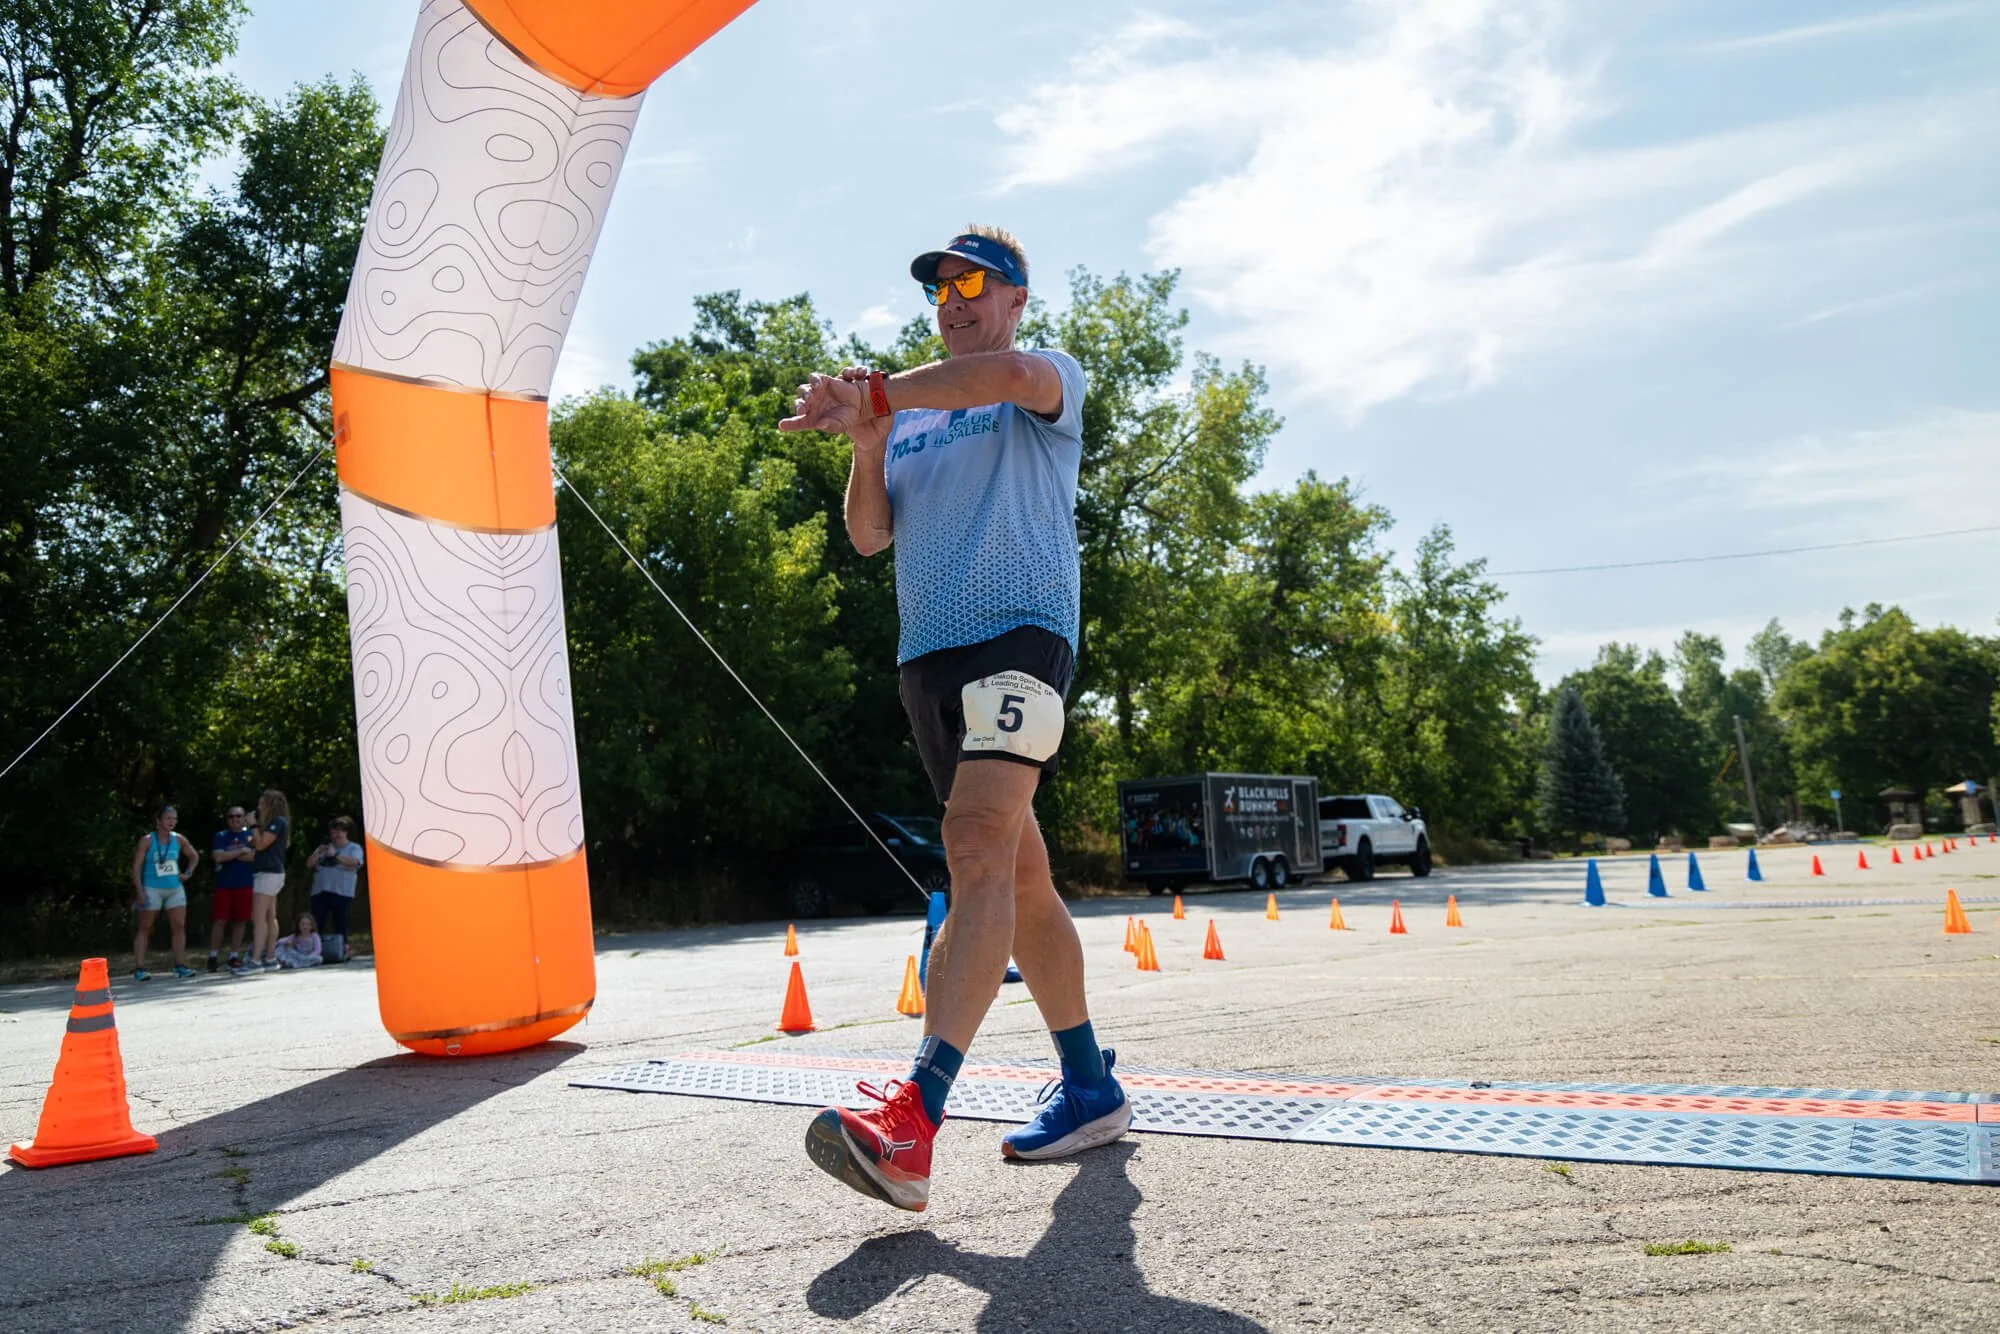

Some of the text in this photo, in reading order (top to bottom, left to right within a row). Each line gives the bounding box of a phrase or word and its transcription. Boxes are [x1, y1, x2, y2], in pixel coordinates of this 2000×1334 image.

[891, 432, 928, 463] 70.3
[991, 679, 1019, 689] Leading
[996, 693, 1026, 733] 5
[1238, 786, 1289, 800] BLACK HILLS
[1238, 800, 1278, 813] RUNNING
